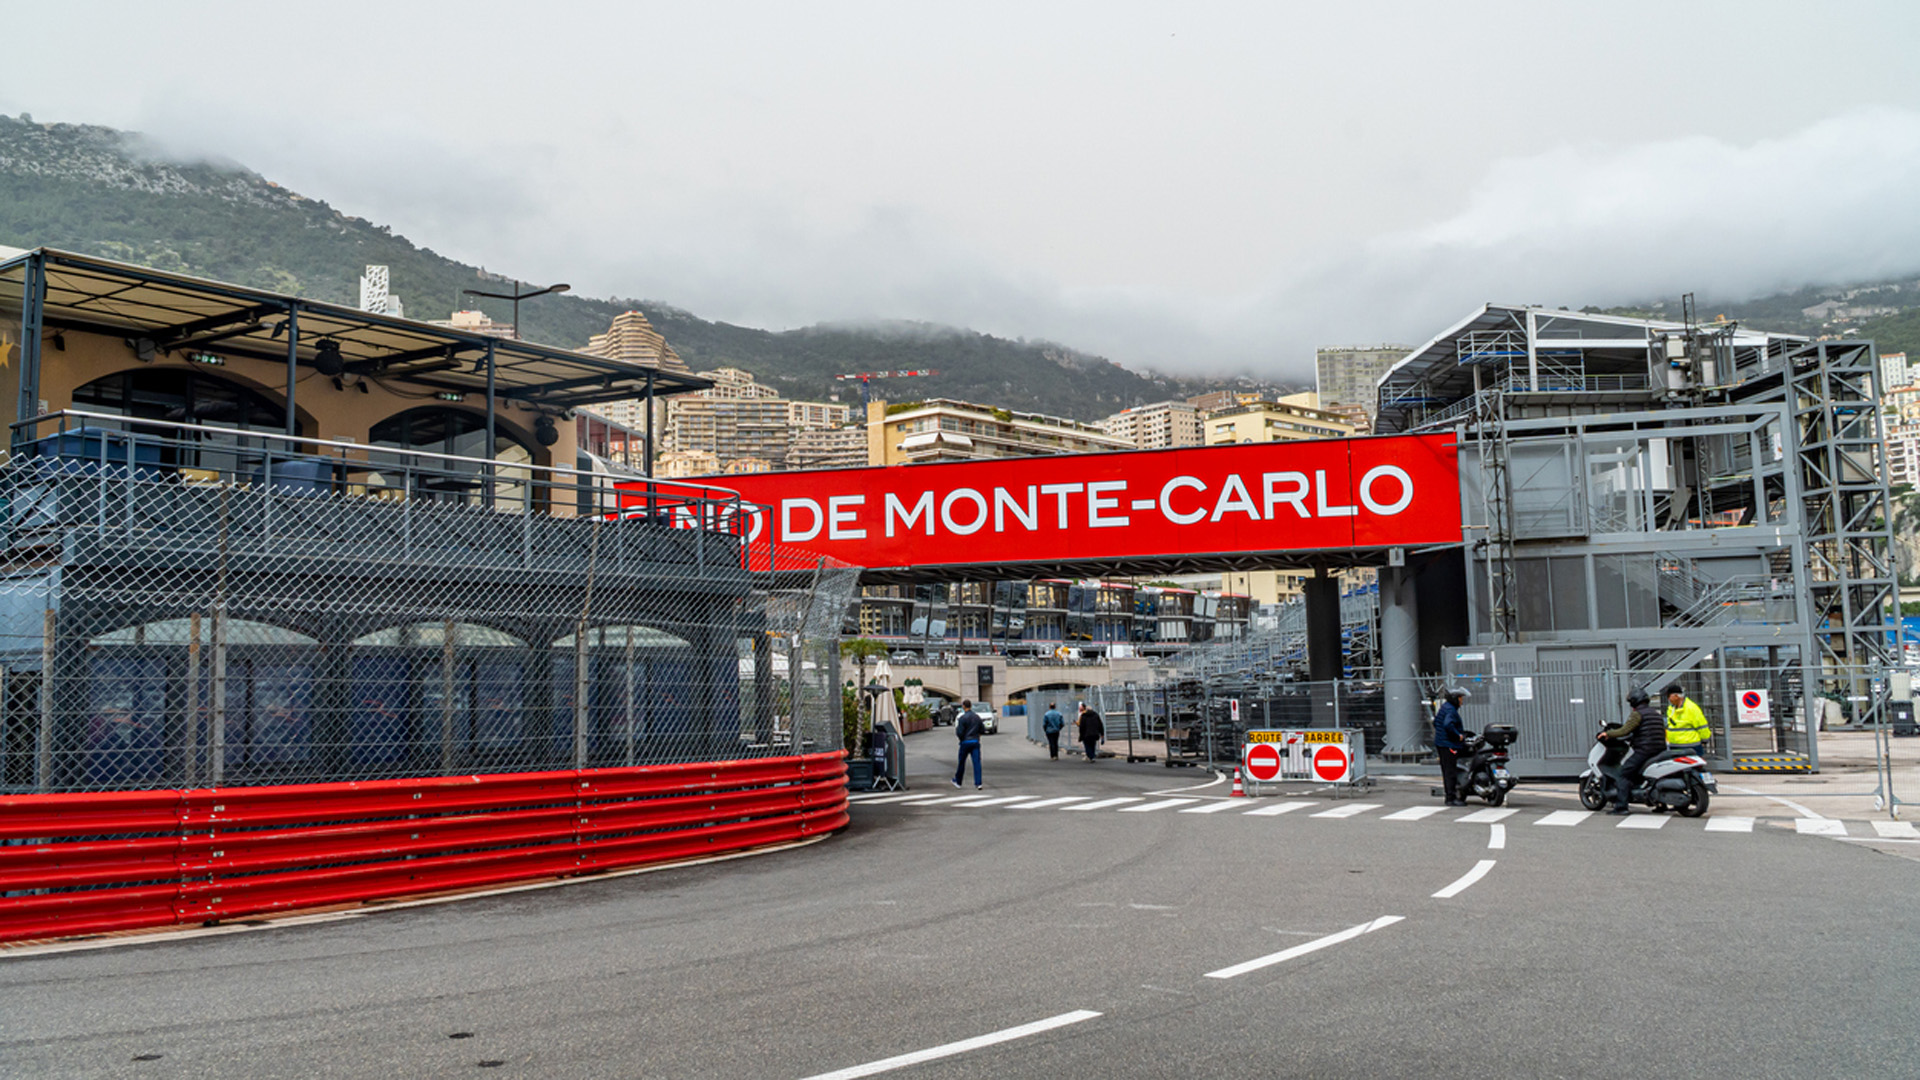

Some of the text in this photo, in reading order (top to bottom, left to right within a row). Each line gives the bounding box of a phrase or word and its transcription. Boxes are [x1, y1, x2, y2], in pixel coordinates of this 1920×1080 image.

[781, 495, 866, 542] DE
[885, 464, 1414, 538] MONTE-CARLO
[1250, 733, 1282, 743] ROUTE
